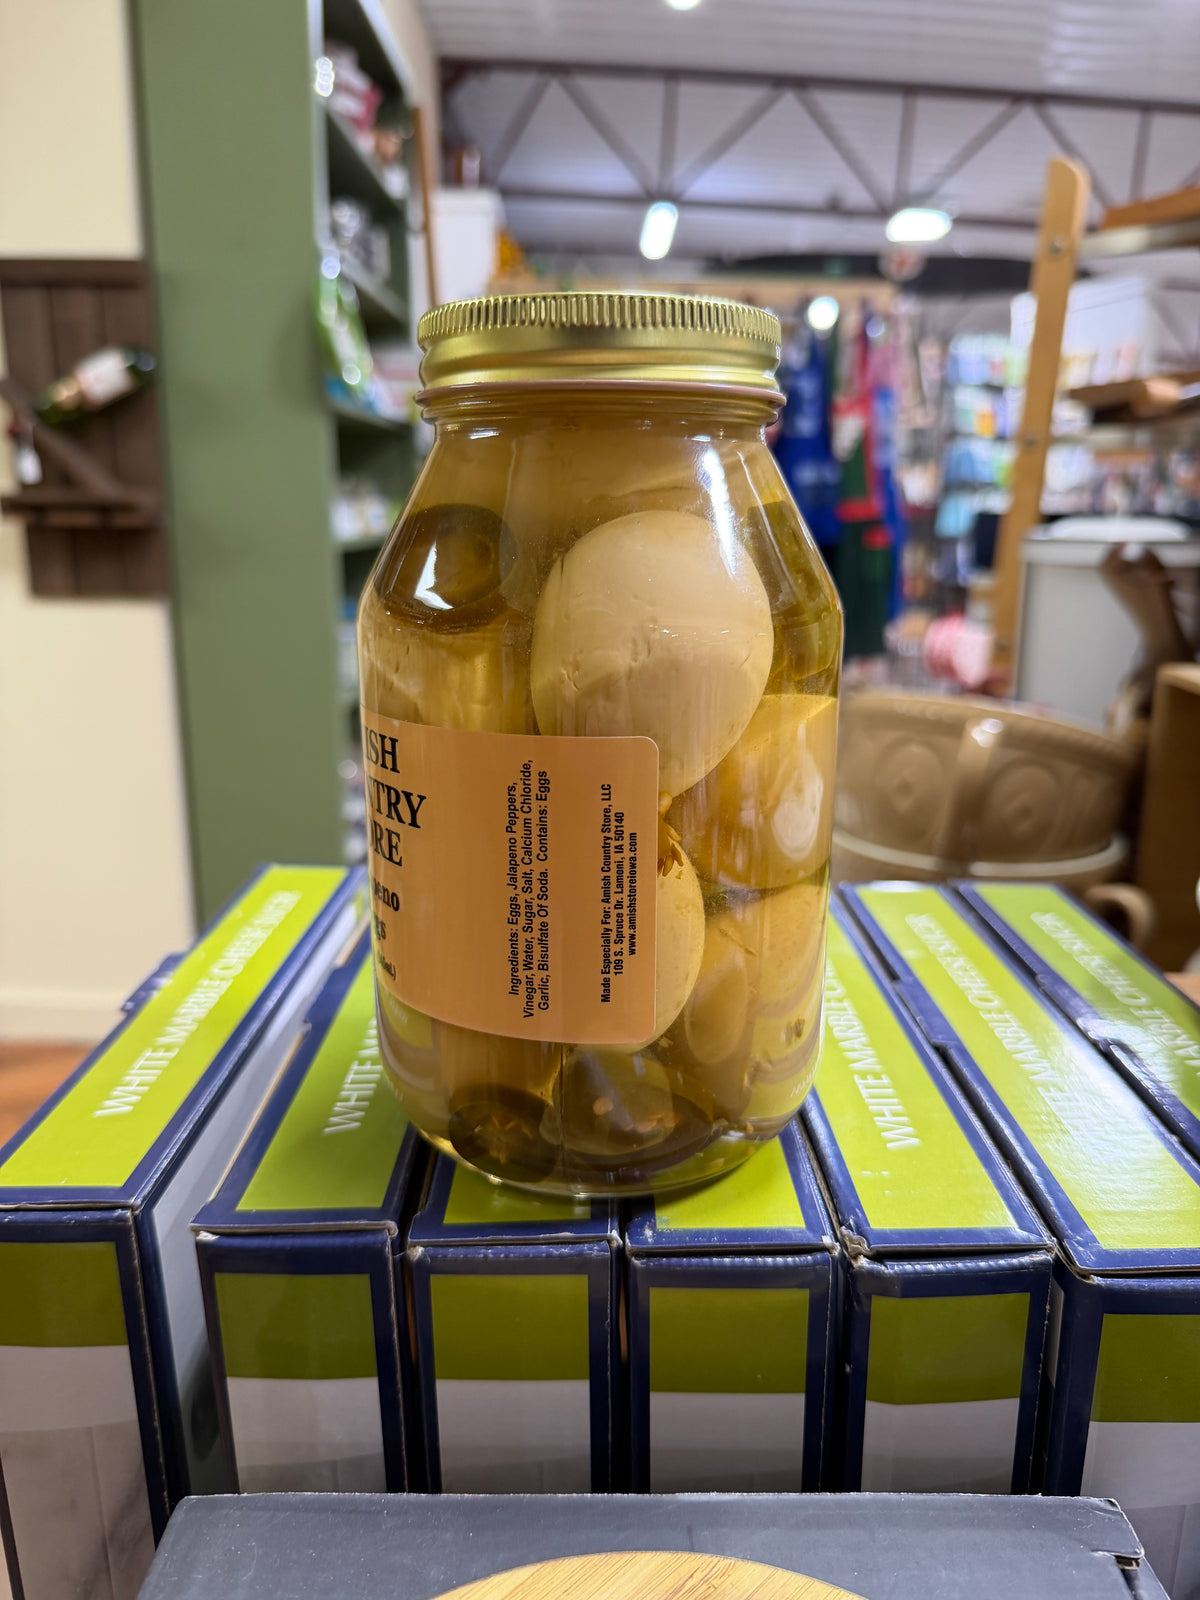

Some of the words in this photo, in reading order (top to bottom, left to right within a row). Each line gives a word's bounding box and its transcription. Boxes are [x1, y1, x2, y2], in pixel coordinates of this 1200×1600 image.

[520, 760, 533, 814] Chloride,
[536, 771, 550, 801] Eggs
[601, 784, 611, 801] LLC
[506, 783, 519, 833] Peppers,
[601, 805, 612, 833] Store,
[521, 818, 532, 865] Calcium
[536, 805, 548, 862] Contains:
[614, 812, 624, 841] 50140
[506, 837, 520, 890] Jalapeno
[601, 836, 613, 872] Country
[614, 844, 624, 853] IA
[522, 869, 534, 894] Salt,
[537, 869, 548, 901] Soda.
[601, 876, 611, 904] Amish
[614, 857, 625, 894] Lamoni,
[507, 894, 521, 925] Eggs,
[537, 904, 548, 918] Of
[614, 898, 623, 910] Dr.
[627, 833, 637, 956] www.amishstoreiowa.com
[522, 898, 536, 933] Sugar,
[601, 907, 611, 925] For:
[614, 913, 625, 944] Spruce
[508, 928, 522, 995] Ingredients:
[523, 937, 535, 971] Water,
[537, 921, 549, 971] Bisulfate
[601, 928, 613, 974] Especially
[614, 948, 623, 956] S.
[614, 959, 623, 976] 109
[523, 974, 536, 1018] Vinegar,
[538, 975, 551, 1010] Garlic,
[601, 977, 610, 1002] Made
[92, 1047, 180, 1118] WHITE
[154, 977, 234, 1044] MARBLE
[979, 1010, 1062, 1082] MARBLE
[323, 1060, 383, 1135] WHITE
[854, 1074, 922, 1151] WHITE
